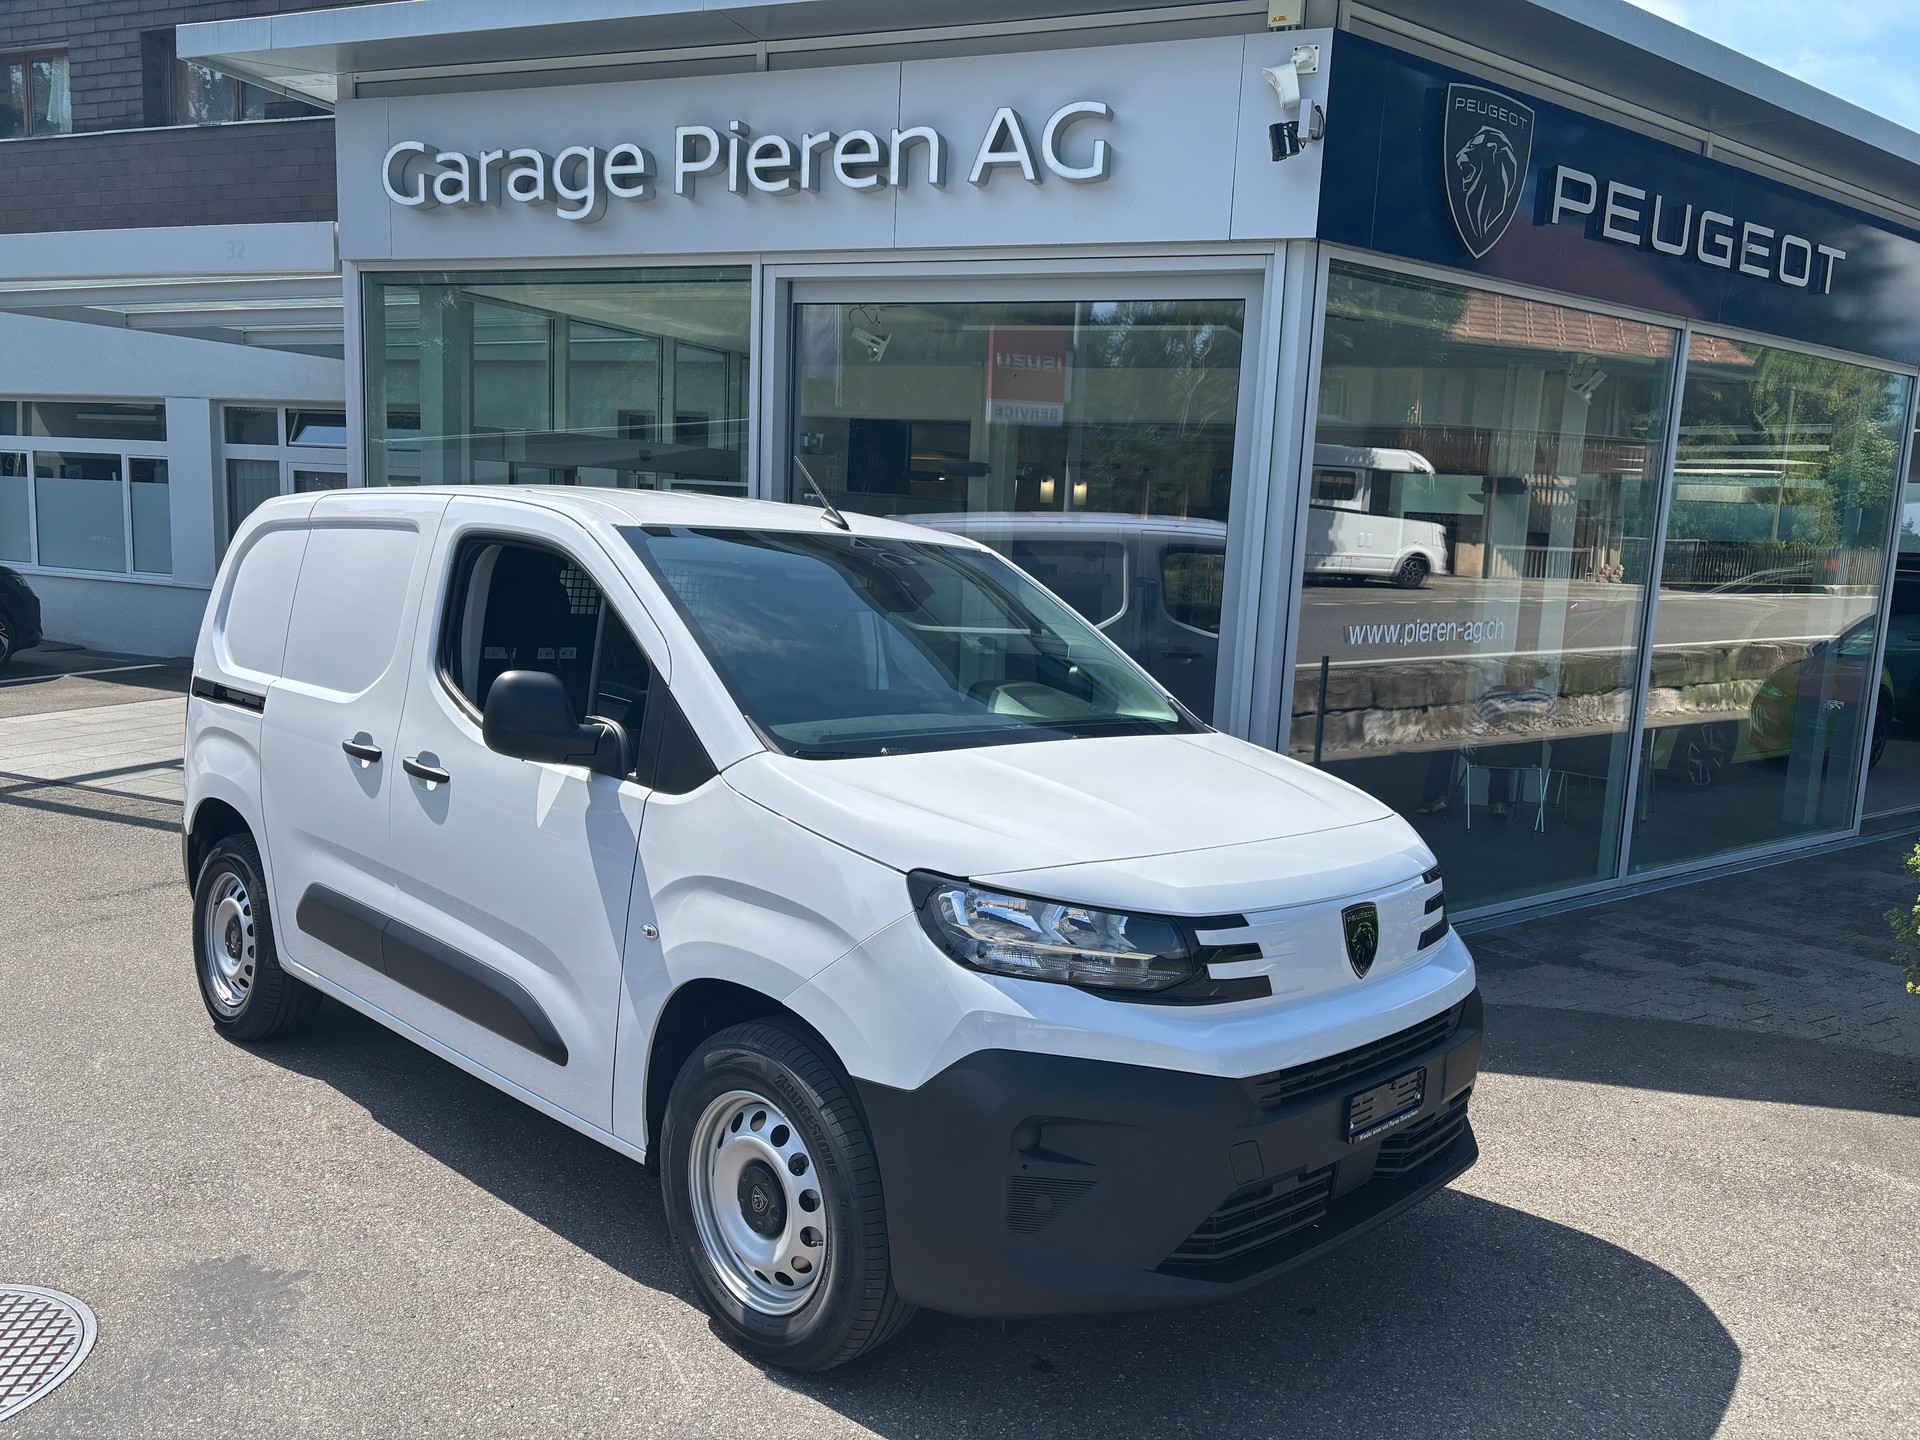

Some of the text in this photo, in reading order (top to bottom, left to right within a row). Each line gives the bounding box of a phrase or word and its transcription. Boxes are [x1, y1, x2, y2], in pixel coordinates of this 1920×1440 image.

[1455, 97, 1528, 130] PEUGEOT
[381, 100, 1112, 221] Garage Pieren AG
[1551, 165, 1847, 295] PEUGEOT
[226, 240, 246, 259] 32
[1349, 618, 1505, 646] www.pieren-ag.ch
[1347, 911, 1375, 922] PEUGEOT
